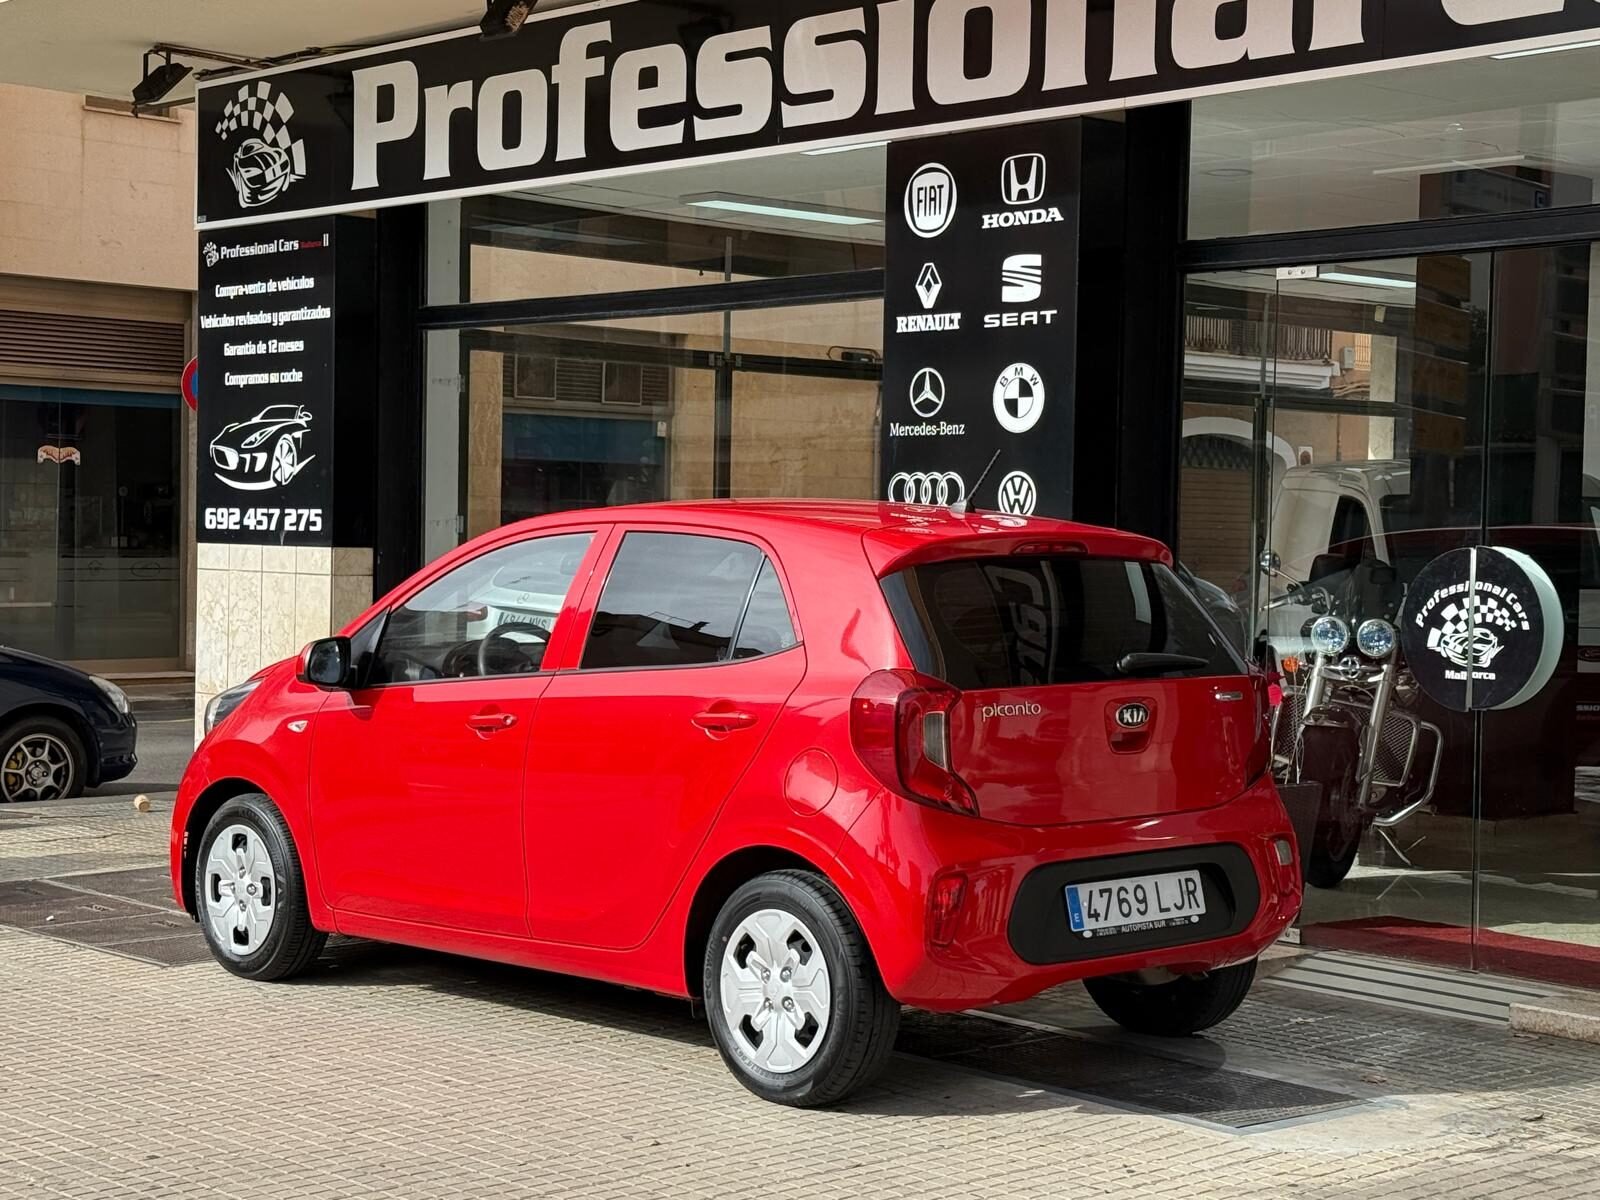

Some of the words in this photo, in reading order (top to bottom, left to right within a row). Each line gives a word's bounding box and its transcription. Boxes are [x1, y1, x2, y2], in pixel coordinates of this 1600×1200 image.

[352, 0, 1364, 191] Professiona
[916, 184, 945, 218] FIAT
[981, 207, 1065, 229] HONDA
[220, 239, 278, 260] Professional
[278, 238, 300, 252] Cars
[215, 281, 267, 300] Compra-venta
[267, 278, 278, 293] de
[235, 309, 272, 326] revisados
[272, 311, 278, 327] y
[278, 304, 332, 327] garantizados
[896, 312, 962, 333] RENAULT
[983, 310, 1058, 328] SEAT
[256, 340, 267, 355] de
[267, 339, 278, 354] 12
[277, 340, 305, 353] meses
[224, 371, 269, 389] Compramos
[269, 372, 280, 384] su
[280, 368, 303, 383] coche
[999, 366, 1040, 388] BMW
[889, 421, 966, 437] Mercedes-Benz
[204, 507, 241, 530] 692
[242, 507, 281, 531] 457
[283, 508, 323, 532] 275
[1415, 580, 1510, 629] Professional
[1505, 591, 1531, 631] Cars
[982, 700, 1042, 723] picanto
[1123, 708, 1146, 723] KIA
[1086, 884, 1149, 922] 4769
[1154, 877, 1201, 914] LJR
[1121, 921, 1154, 933] AUTOPISTA
[1153, 919, 1167, 929] SUR
